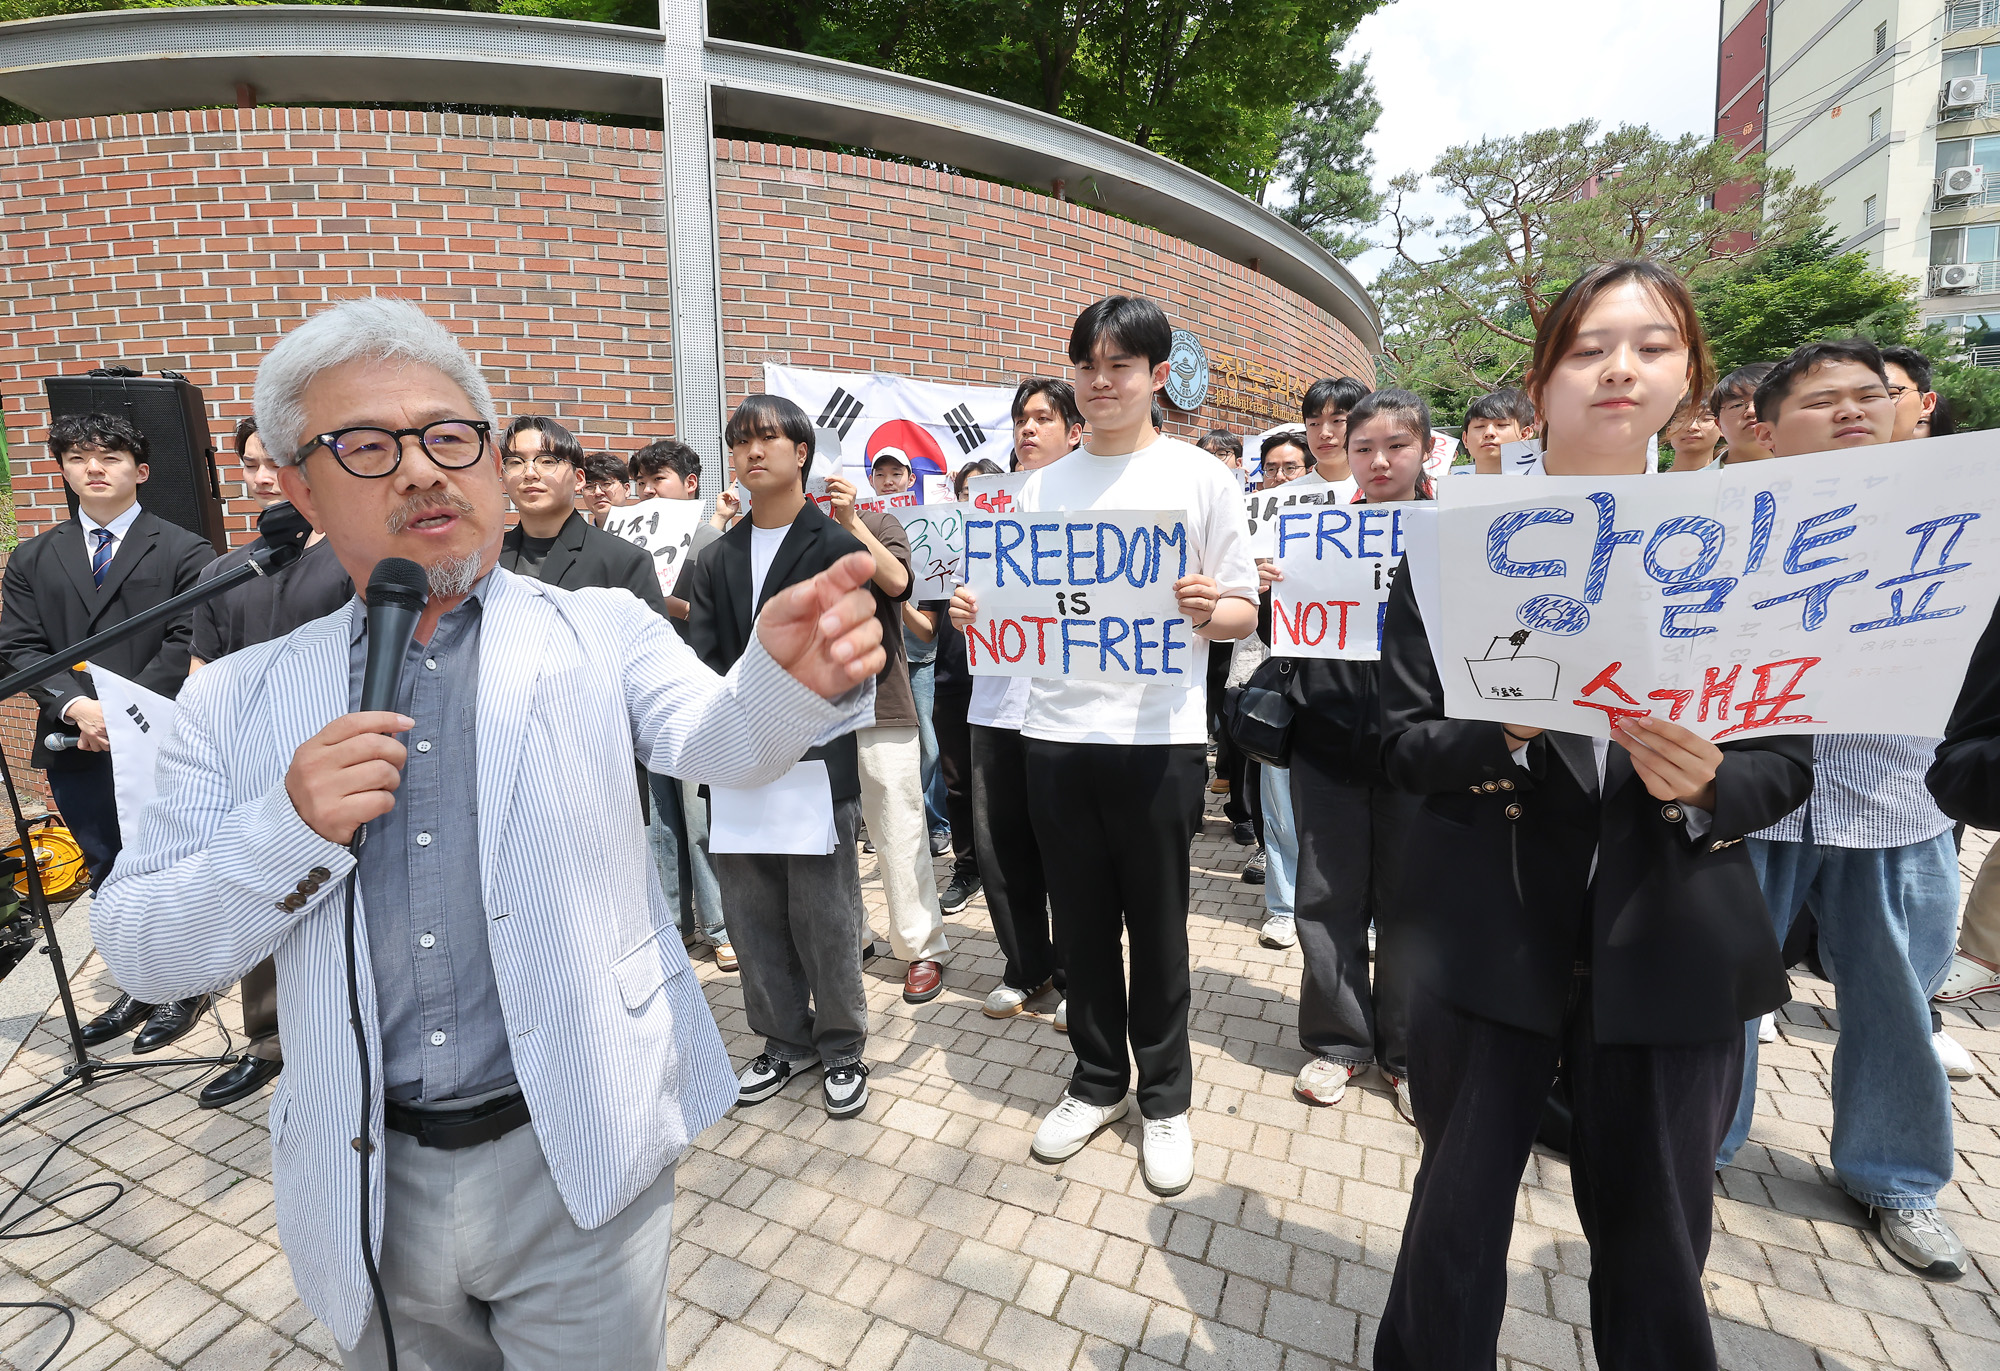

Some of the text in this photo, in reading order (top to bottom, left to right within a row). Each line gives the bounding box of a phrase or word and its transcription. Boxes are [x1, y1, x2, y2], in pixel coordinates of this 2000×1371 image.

[1216, 354, 1308, 406] 장로회신
[965, 520, 1187, 588] FREEDOM
[1055, 592, 1090, 616] is
[1273, 599, 1361, 650] NOT
[965, 615, 1186, 675] NOT FREE
[1573, 657, 1827, 741] 수개표
